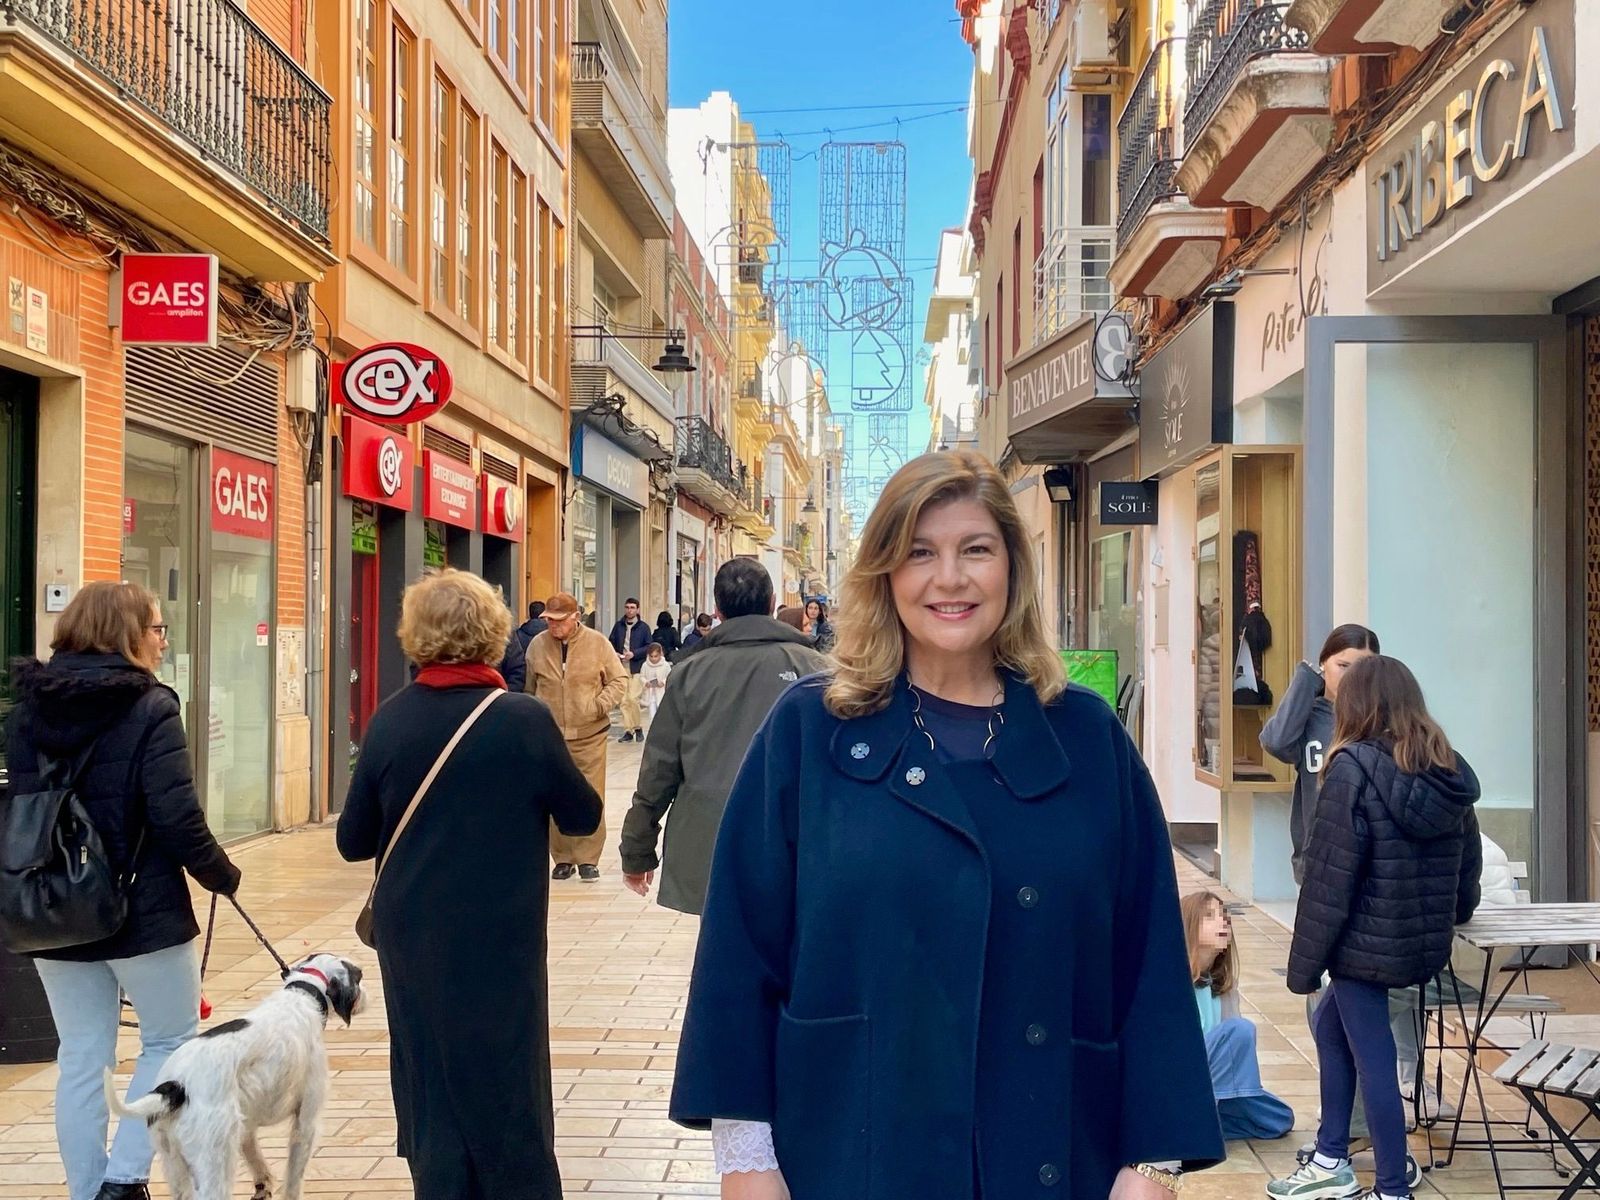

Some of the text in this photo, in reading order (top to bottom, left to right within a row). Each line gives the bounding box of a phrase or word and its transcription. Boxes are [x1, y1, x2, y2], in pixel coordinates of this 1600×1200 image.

[1373, 26, 1563, 261] TRIBECA
[128, 281, 205, 306] GAES
[167, 308, 204, 318] amplifon
[1012, 339, 1089, 418] BENAVENTE
[1164, 412, 1183, 449] SOLE
[215, 467, 268, 522] GAES
[1108, 502, 1152, 513] SOLE
